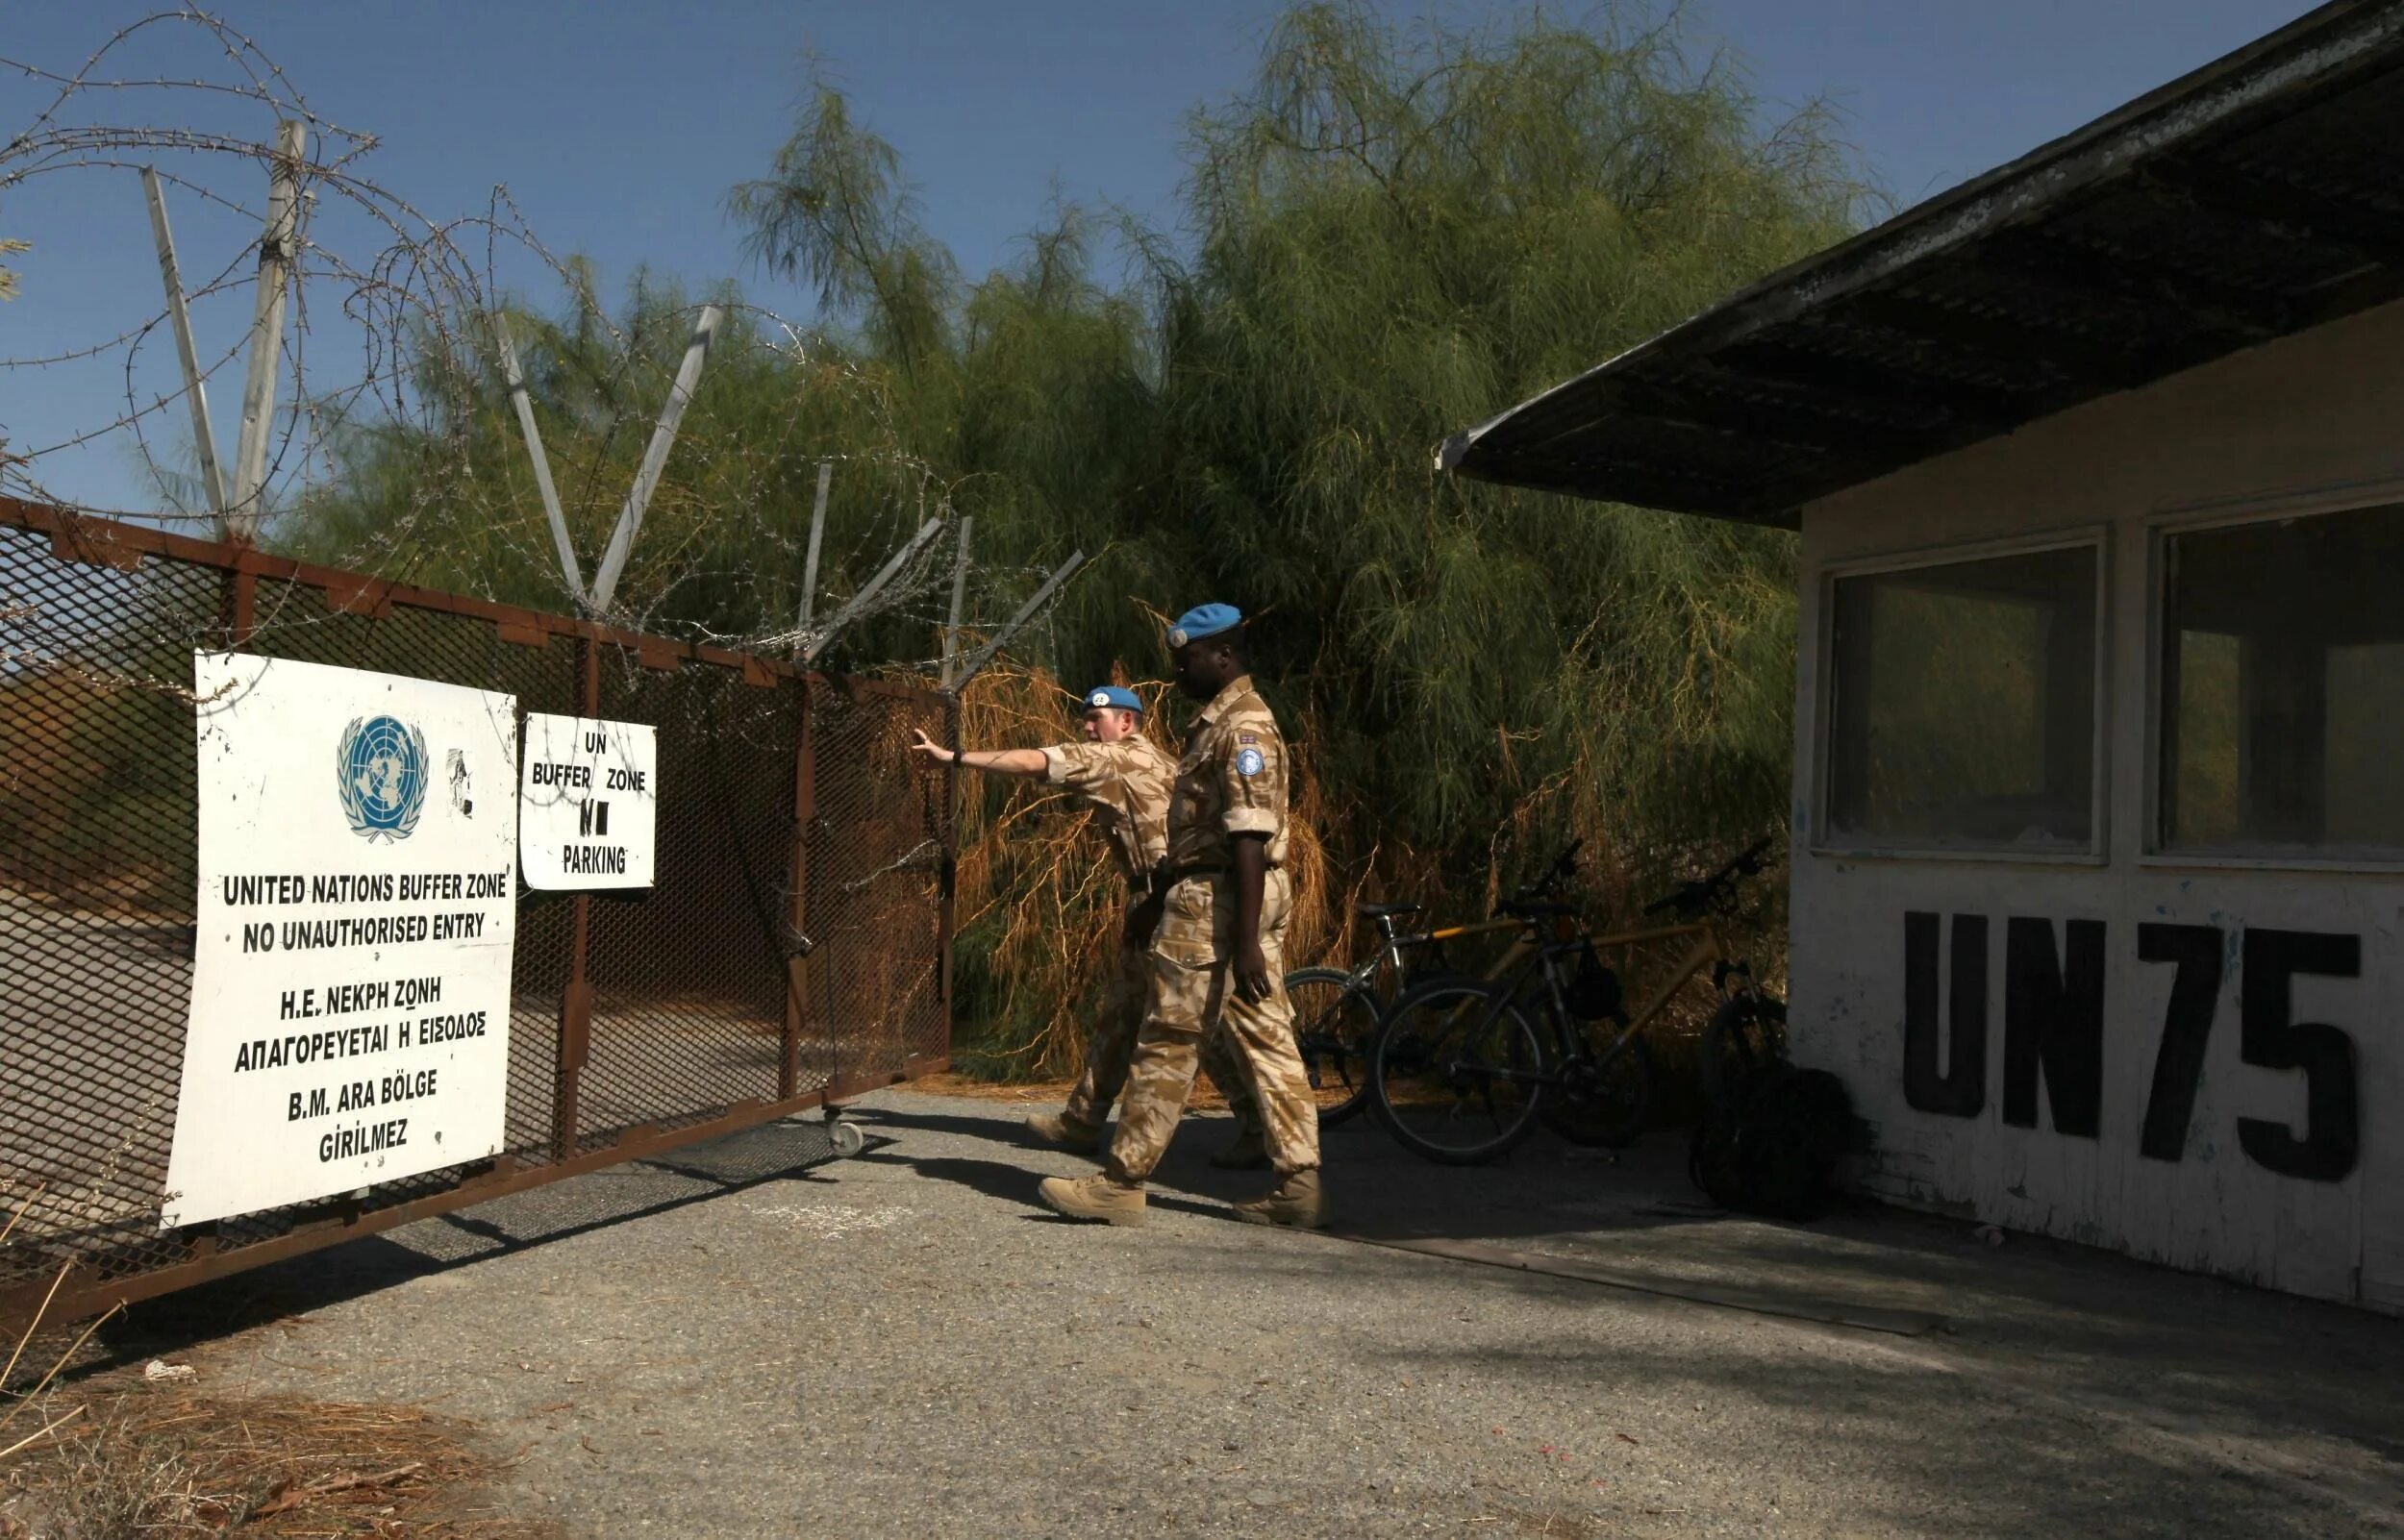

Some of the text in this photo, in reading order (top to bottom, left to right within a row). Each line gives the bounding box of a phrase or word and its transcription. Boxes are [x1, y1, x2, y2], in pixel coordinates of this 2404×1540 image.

[586, 732, 607, 754] UN
[533, 762, 645, 791] BUFFER ZONE
[563, 844, 625, 874] PARKING
[224, 873, 507, 906] UNITED NATIONS BUFFER ZONE
[243, 912, 486, 953] NO UNAUTHORISED ENTRY
[327, 981, 388, 1014] ΝΕΚΡΗ
[234, 1010, 487, 1073] ΑΠΑΓΟΡΕΥΕΤΑΙ Η ΕΙΣΟΔΟΣ
[1901, 910, 2362, 1183] UN 75
[288, 1069, 437, 1121] B.M. ARA BÖLGE
[319, 1118, 408, 1163] GİRİLMEZ
